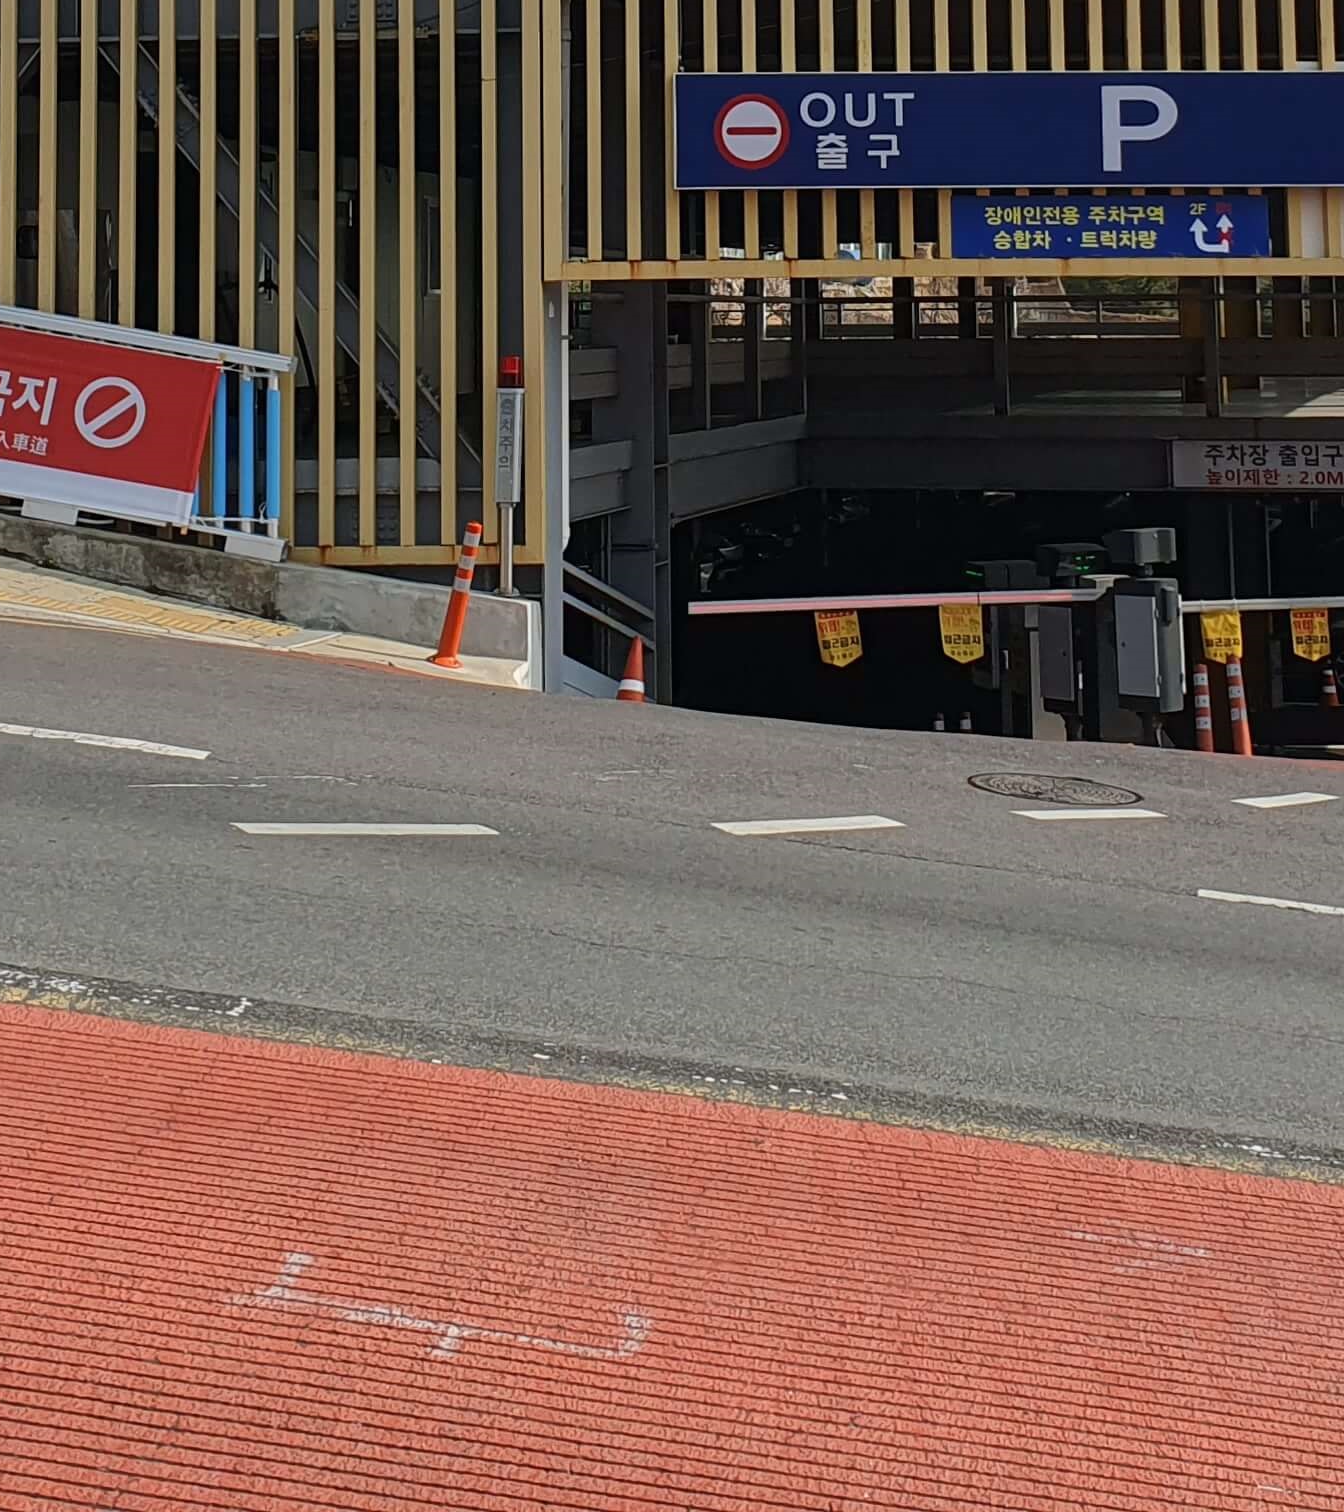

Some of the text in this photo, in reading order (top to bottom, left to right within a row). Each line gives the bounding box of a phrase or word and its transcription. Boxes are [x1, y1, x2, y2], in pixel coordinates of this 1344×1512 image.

[799, 92, 916, 128] OUT
[1099, 84, 1179, 173] P
[984, 205, 1165, 226] 장애인전용 주차구역
[1189, 202, 1207, 216] 2F
[992, 230, 1053, 250] 승합차
[1079, 230, 1158, 250] 트럭차량
[1204, 443, 1344, 467] 주차장 출입구
[1205, 468, 1281, 486] 높이제한
[1299, 470, 1344, 486] 2.0M
